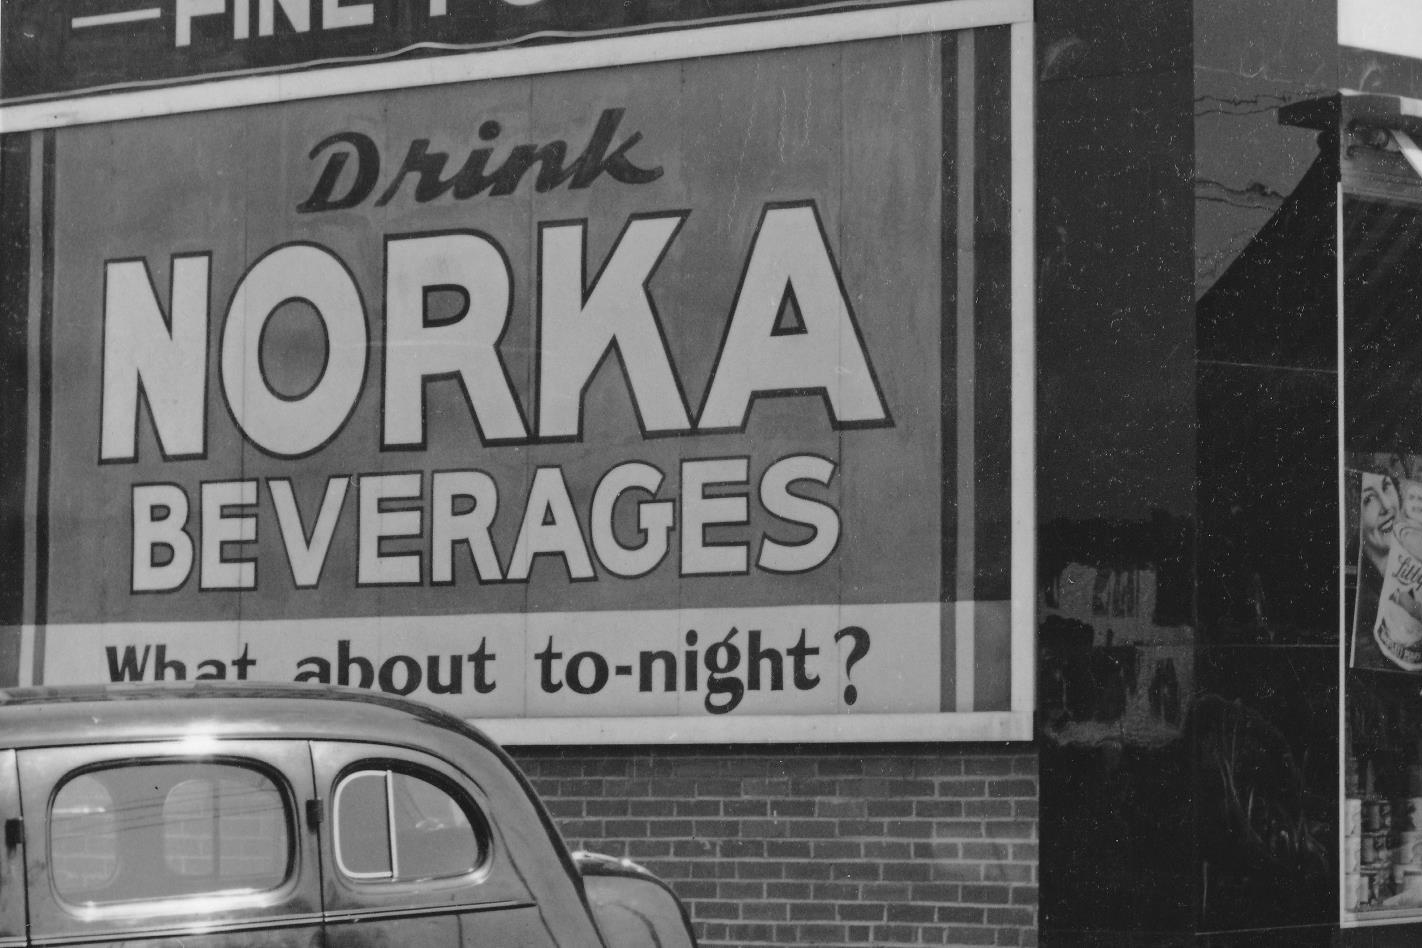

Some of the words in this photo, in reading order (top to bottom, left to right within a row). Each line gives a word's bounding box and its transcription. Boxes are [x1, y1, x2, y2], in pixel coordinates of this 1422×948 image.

[297, 108, 664, 214] Drink
[98, 199, 895, 465] NORKA
[130, 455, 842, 595] BEVERAGES
[105, 642, 257, 682] What
[293, 636, 497, 696] about
